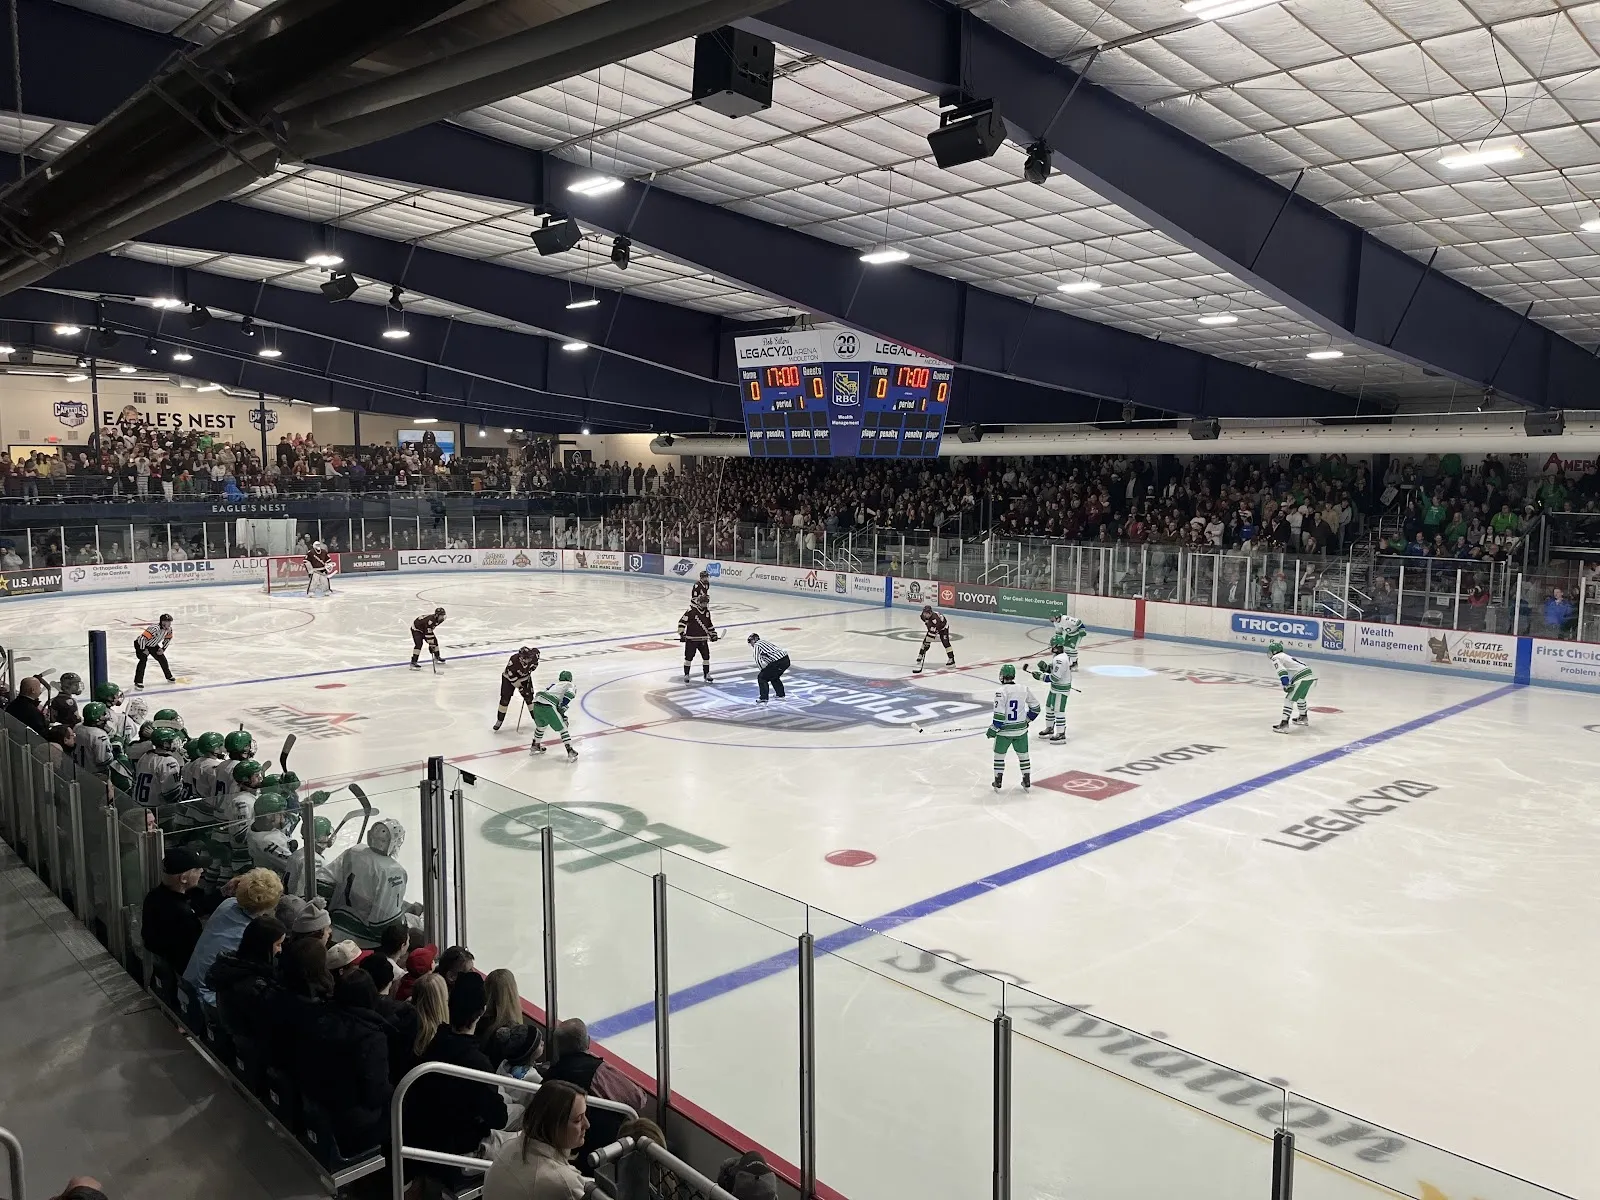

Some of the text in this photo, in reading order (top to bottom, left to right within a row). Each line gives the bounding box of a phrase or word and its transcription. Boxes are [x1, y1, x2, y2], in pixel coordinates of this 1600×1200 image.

[838, 336, 855, 353] 20
[740, 346, 792, 359] LEGACY20
[742, 370, 756, 380] Home
[768, 366, 799, 386] 17:00
[803, 366, 822, 376] Guests
[873, 366, 888, 376] Home
[898, 366, 930, 388] 17:00
[933, 370, 950, 380] Guests
[751, 381, 760, 401] 0
[813, 377, 824, 398] 0
[877, 378, 887, 398] 0
[938, 382, 948, 402] 0
[776, 399, 792, 409] period
[800, 396, 804, 409] 1
[898, 400, 915, 410] period
[922, 398, 926, 411] 1
[54, 403, 89, 417] CAPITOLS
[189, 414, 236, 429] NEST
[861, 429, 876, 438] player
[879, 429, 898, 439] penalty
[905, 430, 922, 440] penalty
[926, 430, 939, 440] player
[212, 504, 256, 513] EAGLE'S
[233, 558, 268, 569] ALDO
[400, 555, 472, 565] LEGACY20
[148, 561, 215, 574] SONDEL
[677, 563, 690, 572] TDS
[12, 575, 61, 588] U.S. ARMY
[794, 577, 828, 590] ACTUATE
[854, 583, 884, 593] Management
[958, 591, 997, 605] TOYOTA
[1239, 617, 1305, 635] TRICOR
[1361, 627, 1394, 638] Wealth
[1236, 635, 1313, 648] INSURANCE
[1324, 640, 1342, 649] RBC
[1360, 638, 1423, 652] Management
[1474, 641, 1503, 651] STATE
[1457, 648, 1508, 661] CHAMPIONS
[1536, 646, 1564, 657] First
[1561, 667, 1596, 676] Problem
[1008, 700, 1018, 721] 3
[1105, 743, 1230, 776] TOYOTA
[135, 772, 153, 802] 16
[1261, 779, 1440, 851] LEGACY20
[880, 946, 1408, 1164] SC Aviation
